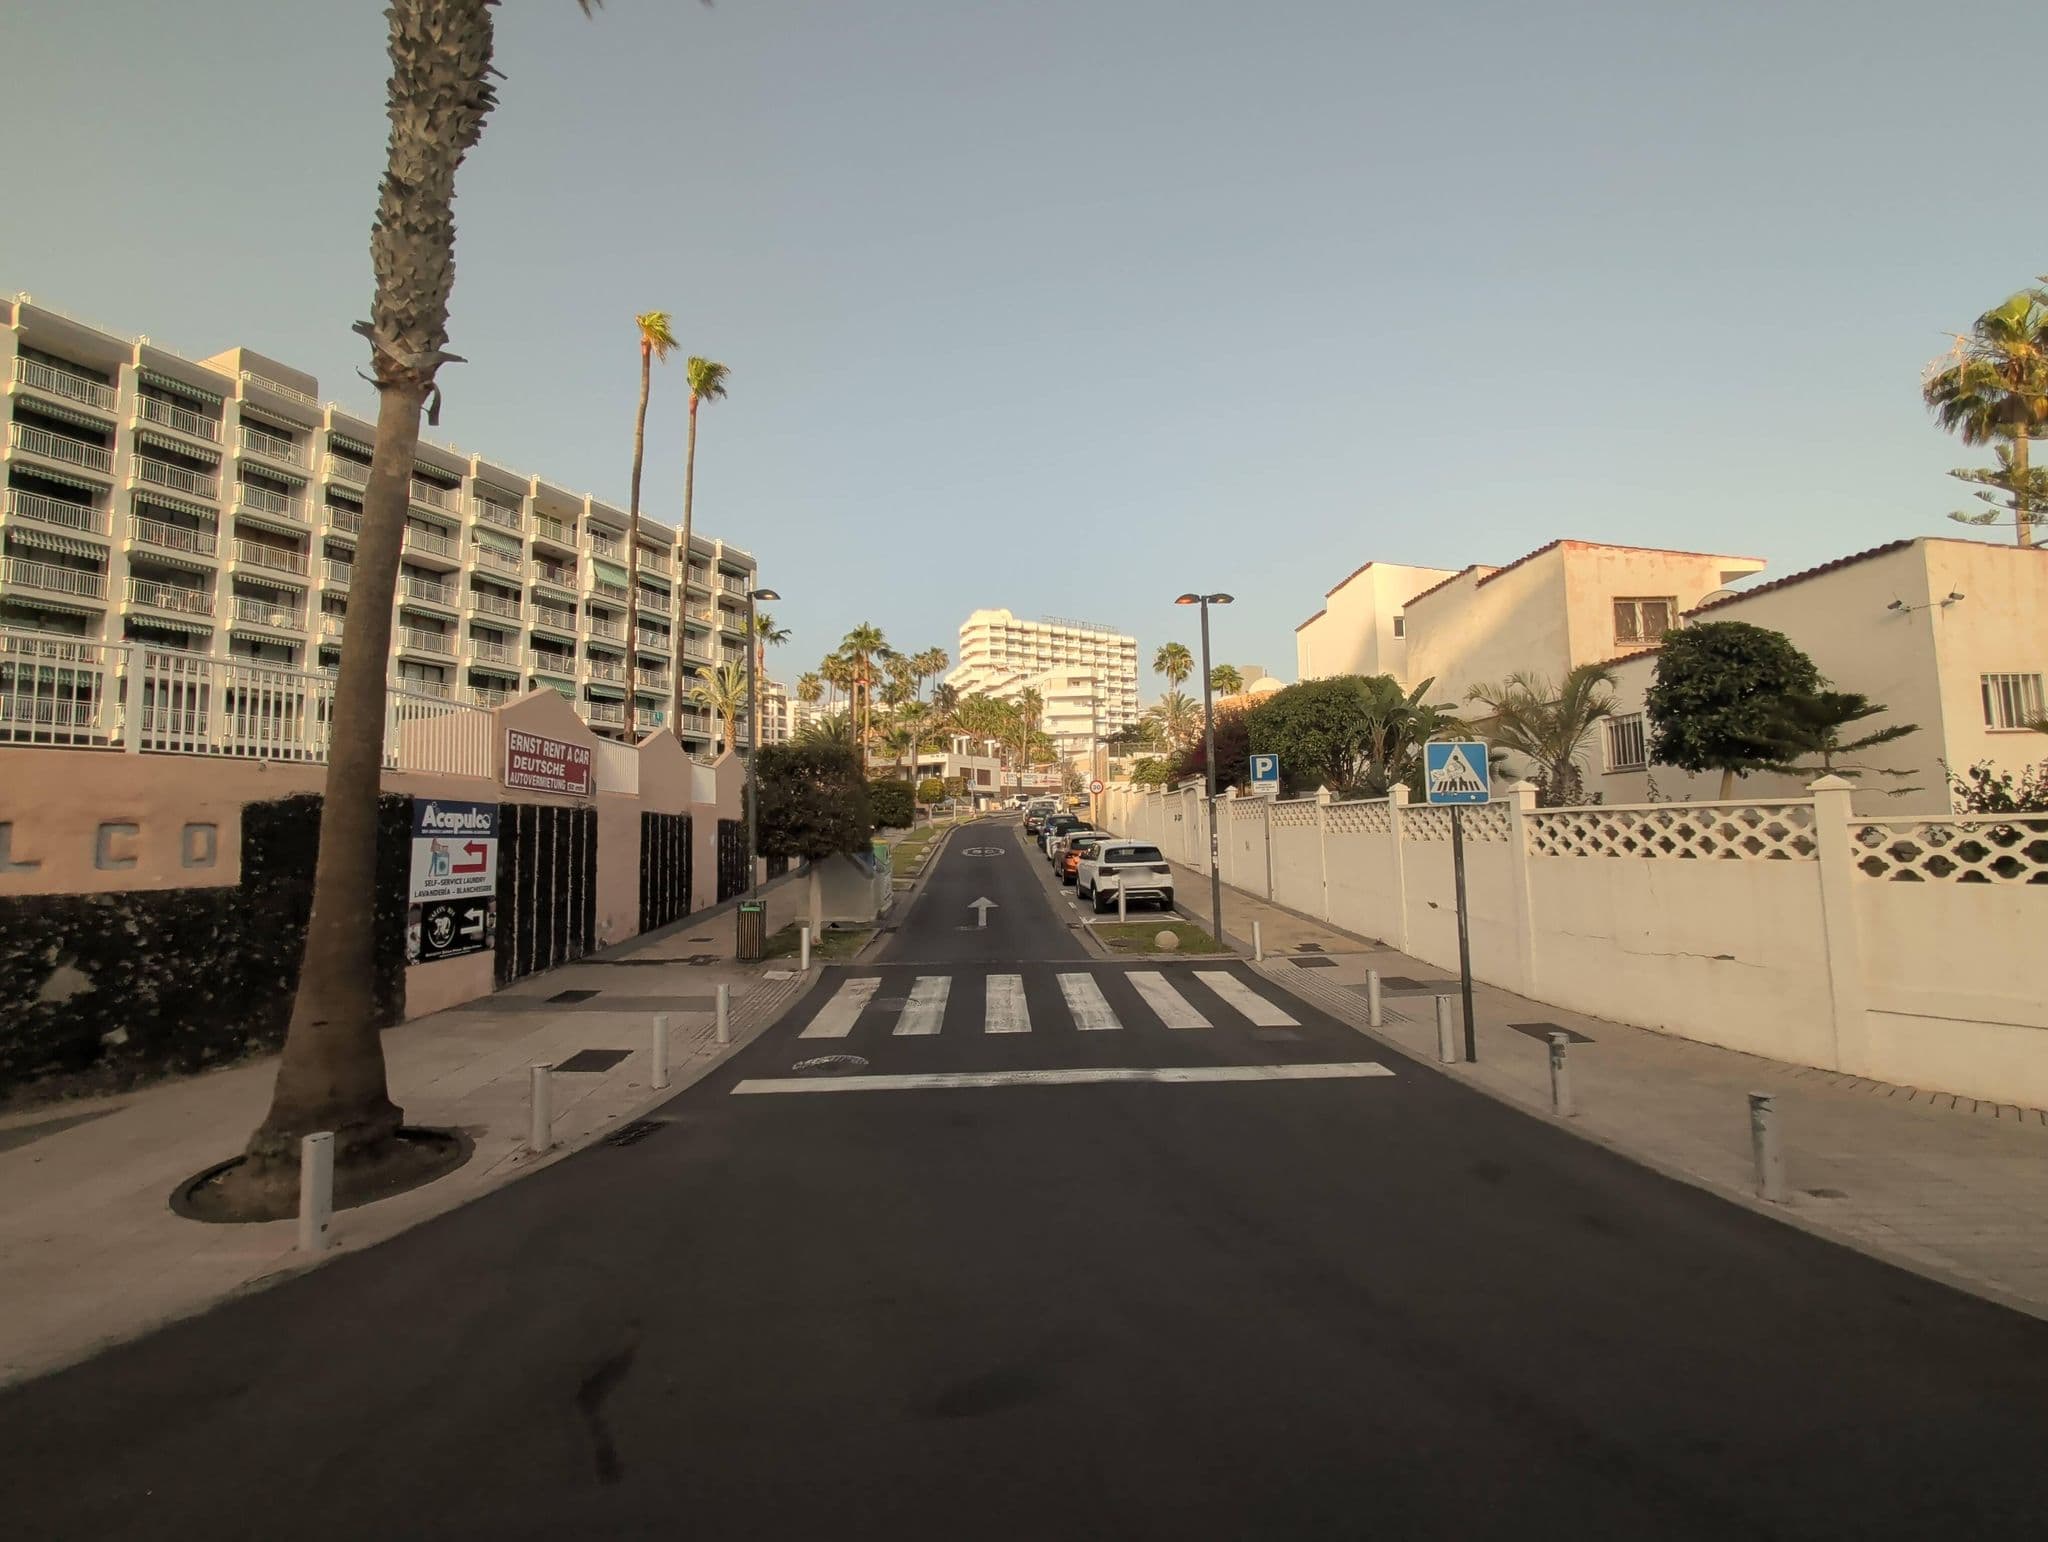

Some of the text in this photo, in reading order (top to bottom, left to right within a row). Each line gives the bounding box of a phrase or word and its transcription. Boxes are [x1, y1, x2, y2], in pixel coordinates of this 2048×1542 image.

[510, 732, 590, 765] ERNST RENT A CAR
[513, 754, 566, 776] DEUTSCHE
[1256, 757, 1273, 778] P
[421, 805, 491, 834] Acapulco
[424, 878, 462, 887] SELF-SERVICE
